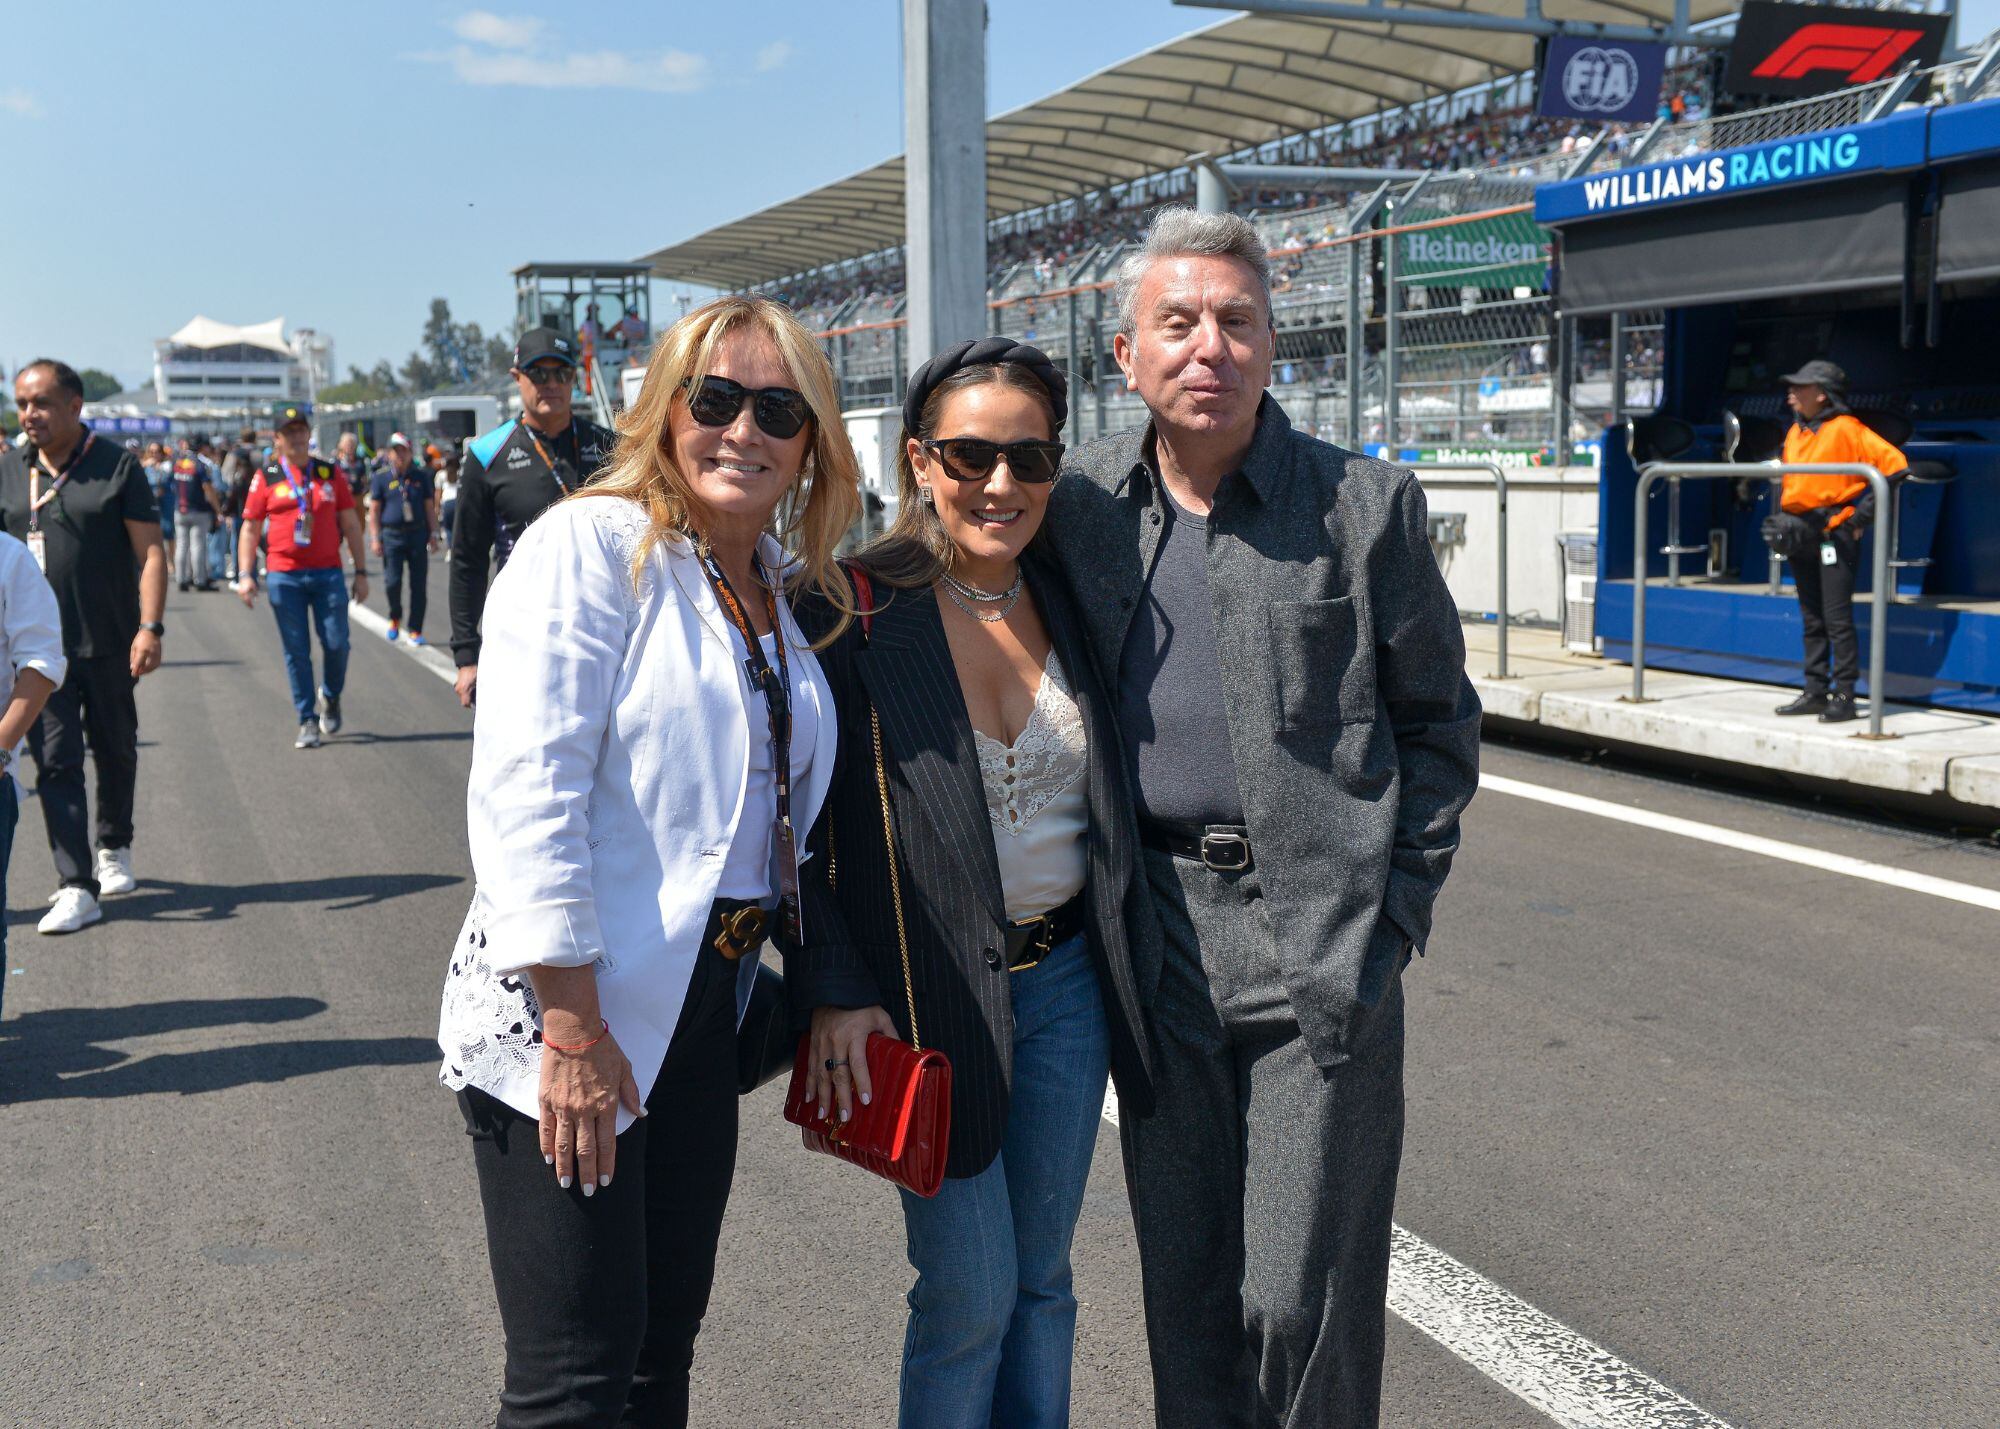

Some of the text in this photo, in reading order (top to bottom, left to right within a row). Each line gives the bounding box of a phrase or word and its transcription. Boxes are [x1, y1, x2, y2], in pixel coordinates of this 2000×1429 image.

[1568, 59, 1629, 98] FIA
[1584, 133, 1859, 210] WILLIAMS RACING
[1407, 234, 1537, 264] Heineken
